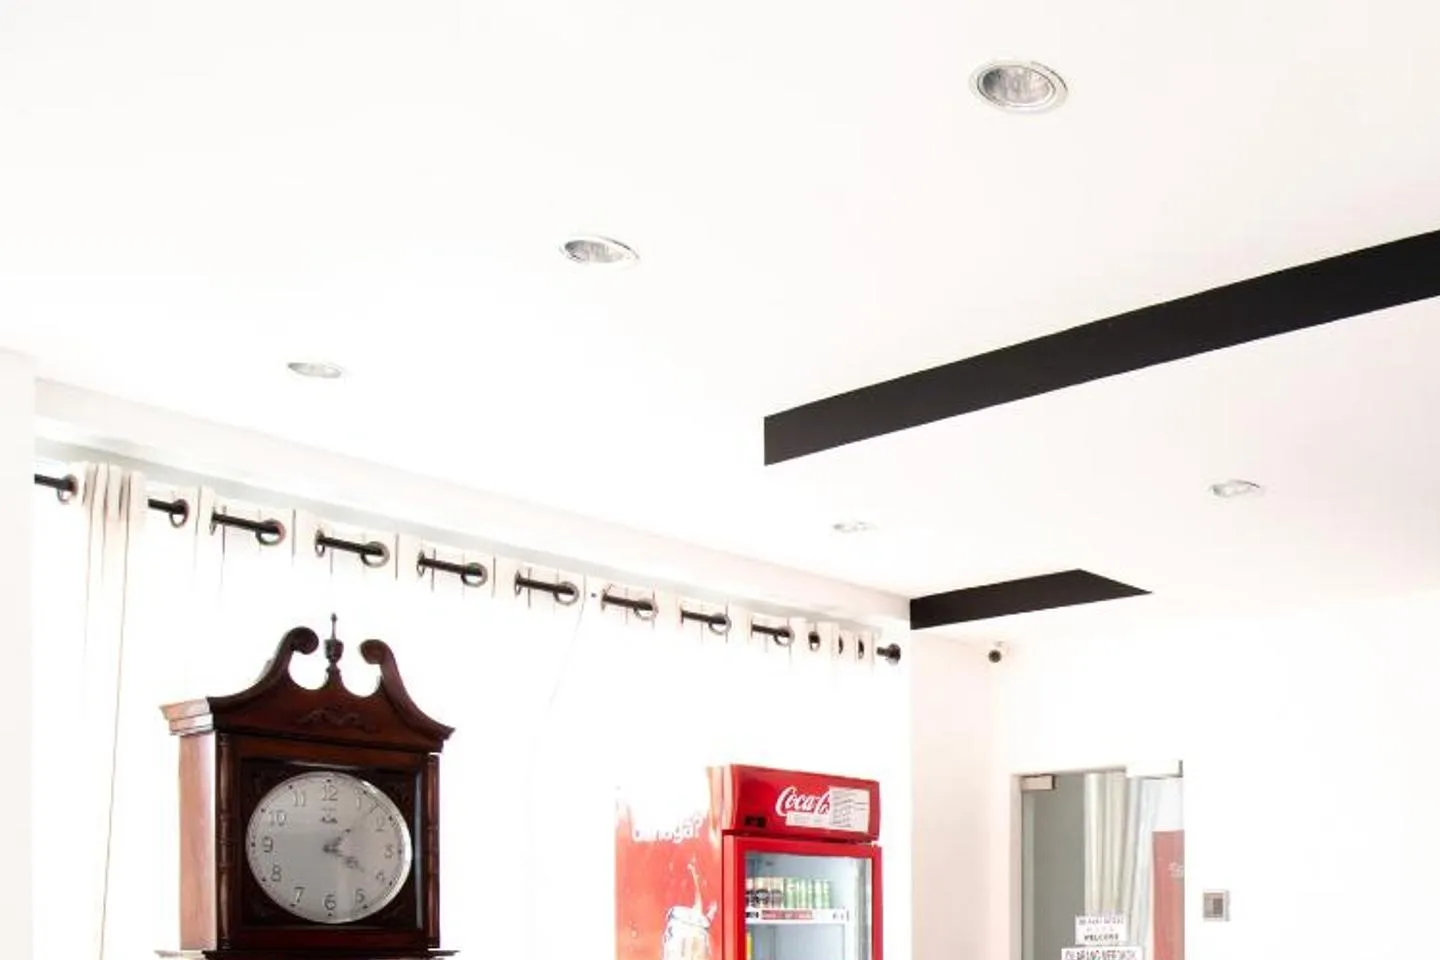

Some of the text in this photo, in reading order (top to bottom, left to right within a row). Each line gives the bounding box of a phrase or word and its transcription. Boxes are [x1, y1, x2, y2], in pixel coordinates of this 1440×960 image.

[321, 784, 339, 802] 12
[261, 835, 274, 853] 9
[270, 864, 282, 883] 8
[294, 886, 306, 903] 7
[323, 894, 337, 911] 6
